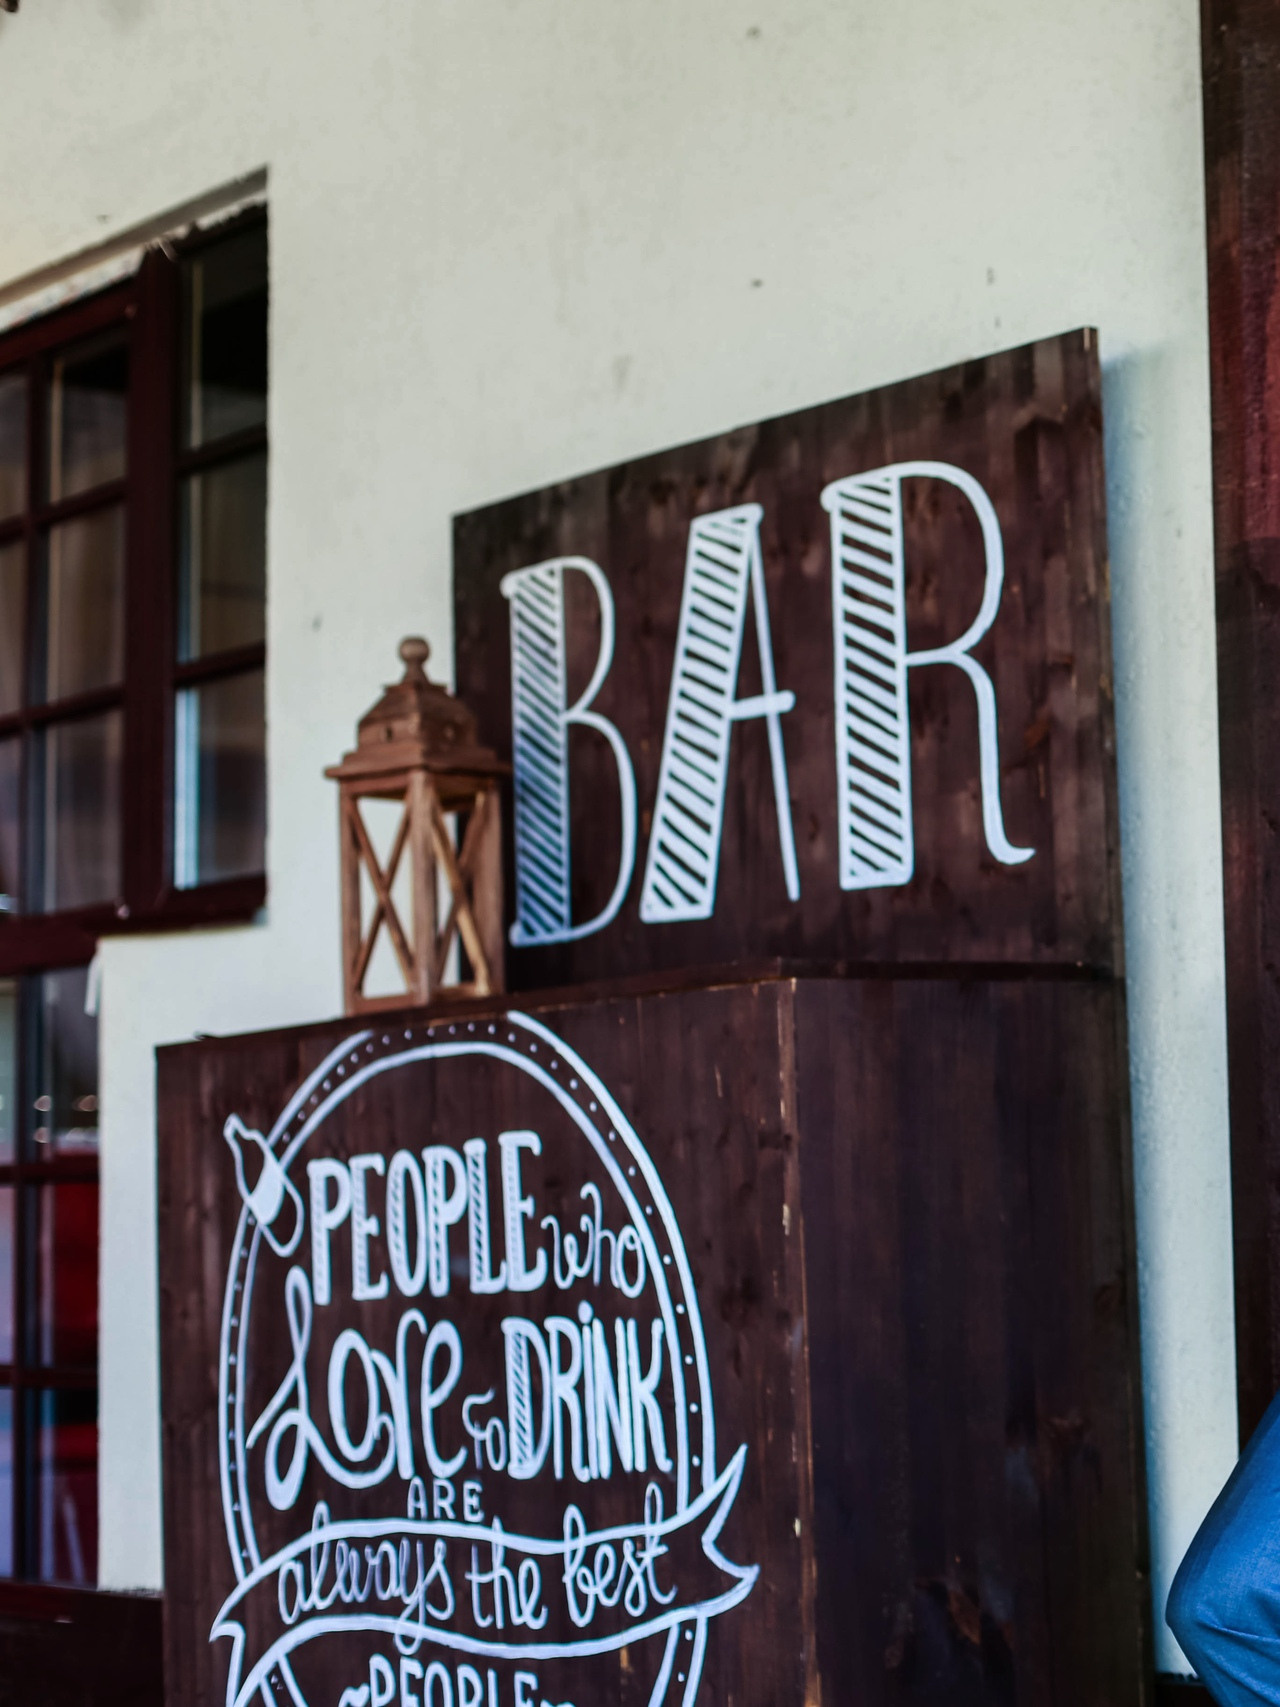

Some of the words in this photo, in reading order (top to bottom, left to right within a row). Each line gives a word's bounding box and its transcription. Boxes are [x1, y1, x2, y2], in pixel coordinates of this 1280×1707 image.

[500, 460, 1035, 947] BAR
[306, 1130, 548, 1305] PEOPLE
[541, 1182, 646, 1298] who
[407, 1477, 485, 1522] ARE
[462, 1386, 507, 1471] to
[277, 1500, 455, 1655] always
[465, 1516, 547, 1629] the
[563, 1482, 677, 1627] best
